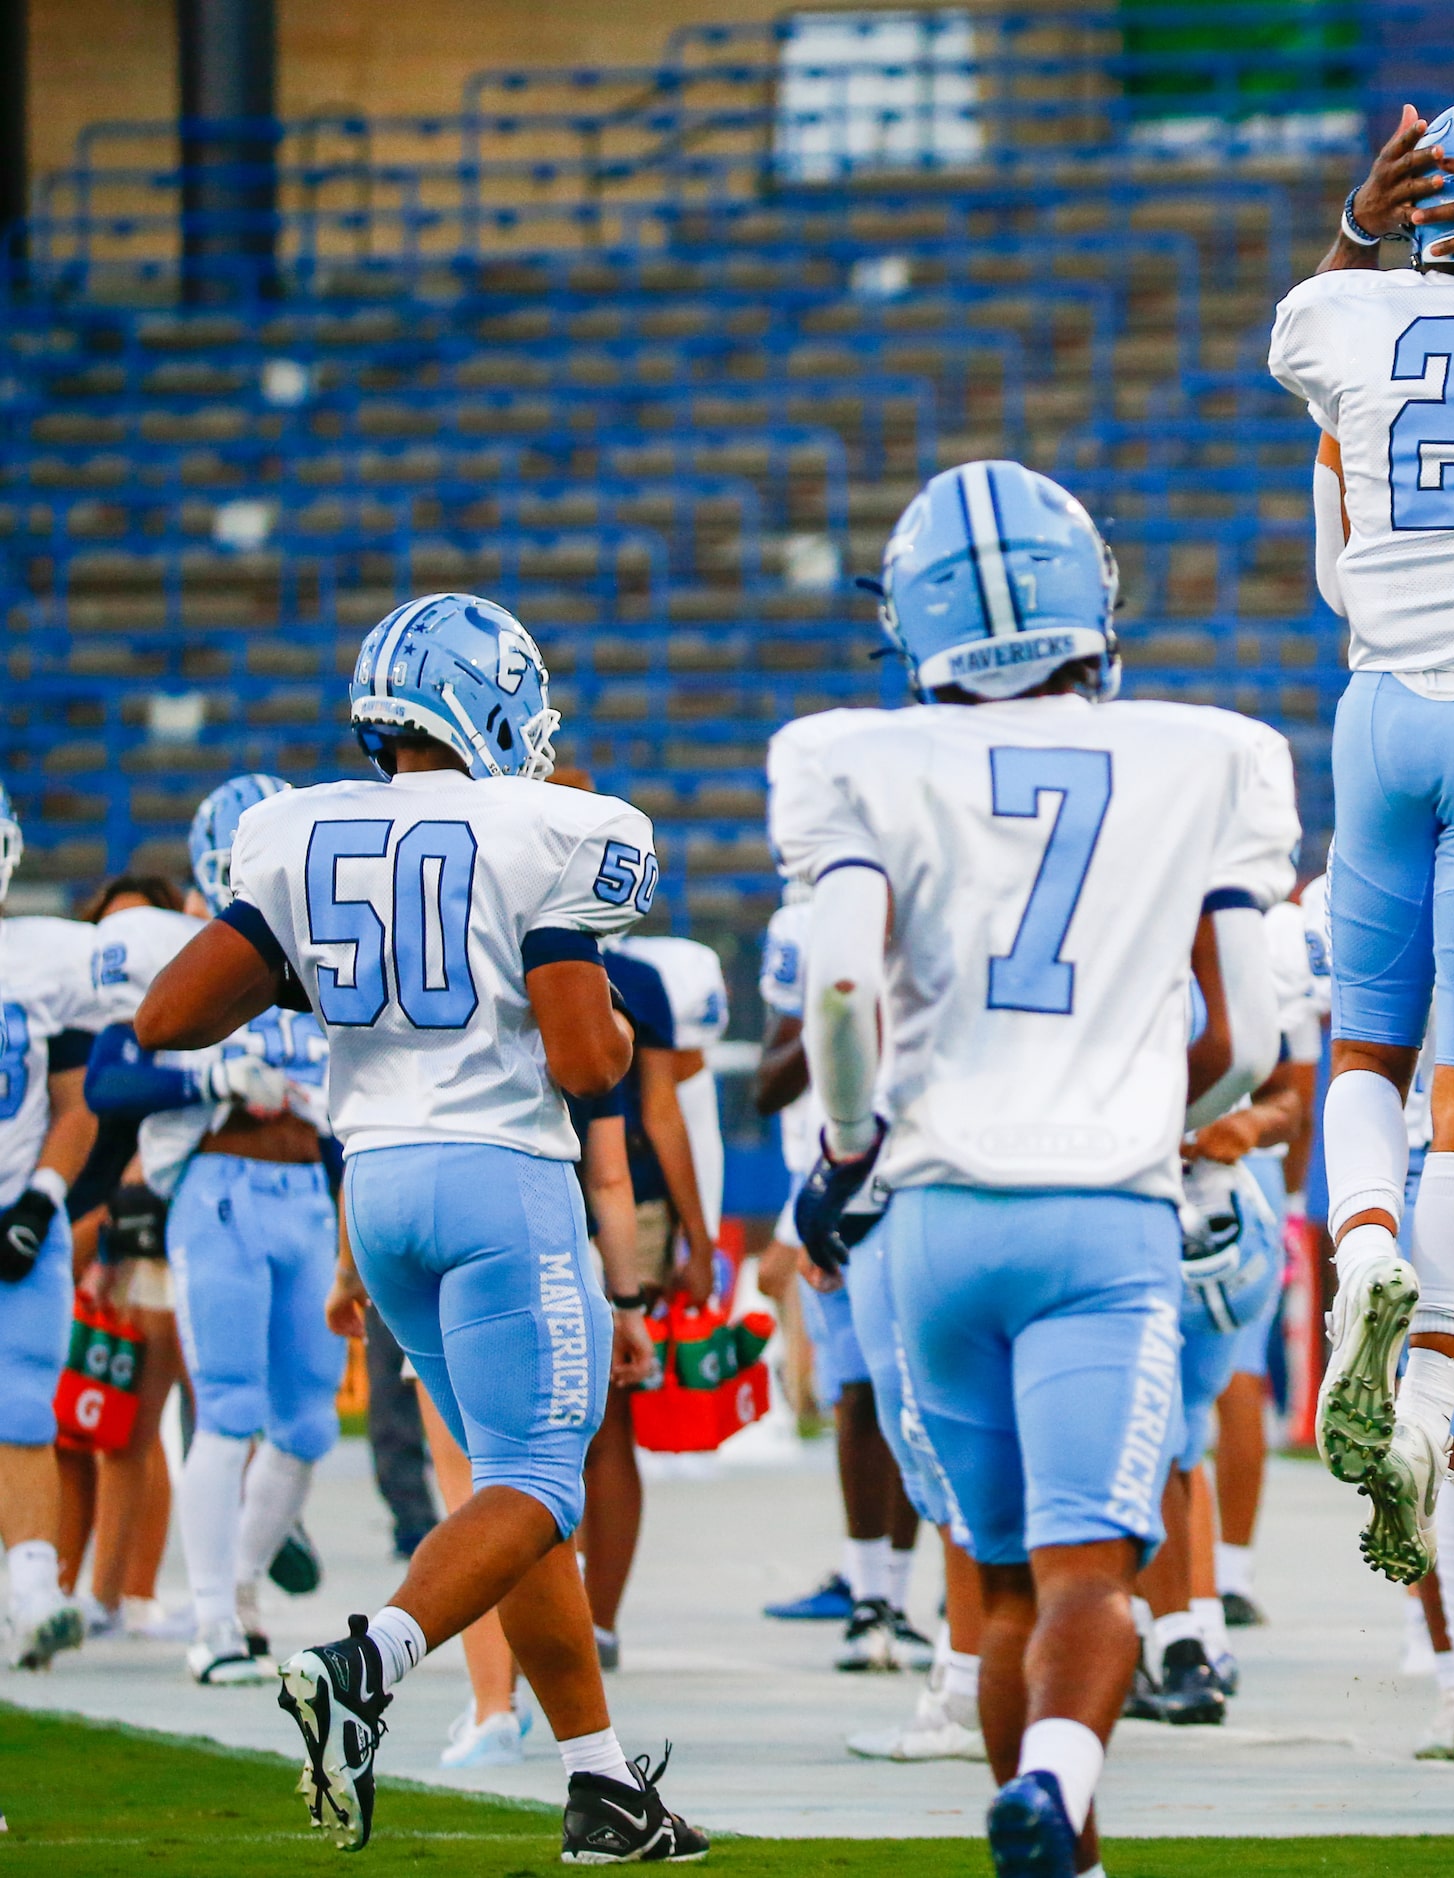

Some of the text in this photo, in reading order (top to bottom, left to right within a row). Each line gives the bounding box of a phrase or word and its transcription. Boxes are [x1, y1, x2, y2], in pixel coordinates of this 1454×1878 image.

[948, 634, 1074, 677] MAVERICKS
[304, 818, 480, 1030] 50
[592, 838, 660, 916] 50
[986, 746, 1113, 1015] 7
[538, 1250, 591, 1427] MAVERICKS
[1105, 1295, 1180, 1534] MAVERICKS
